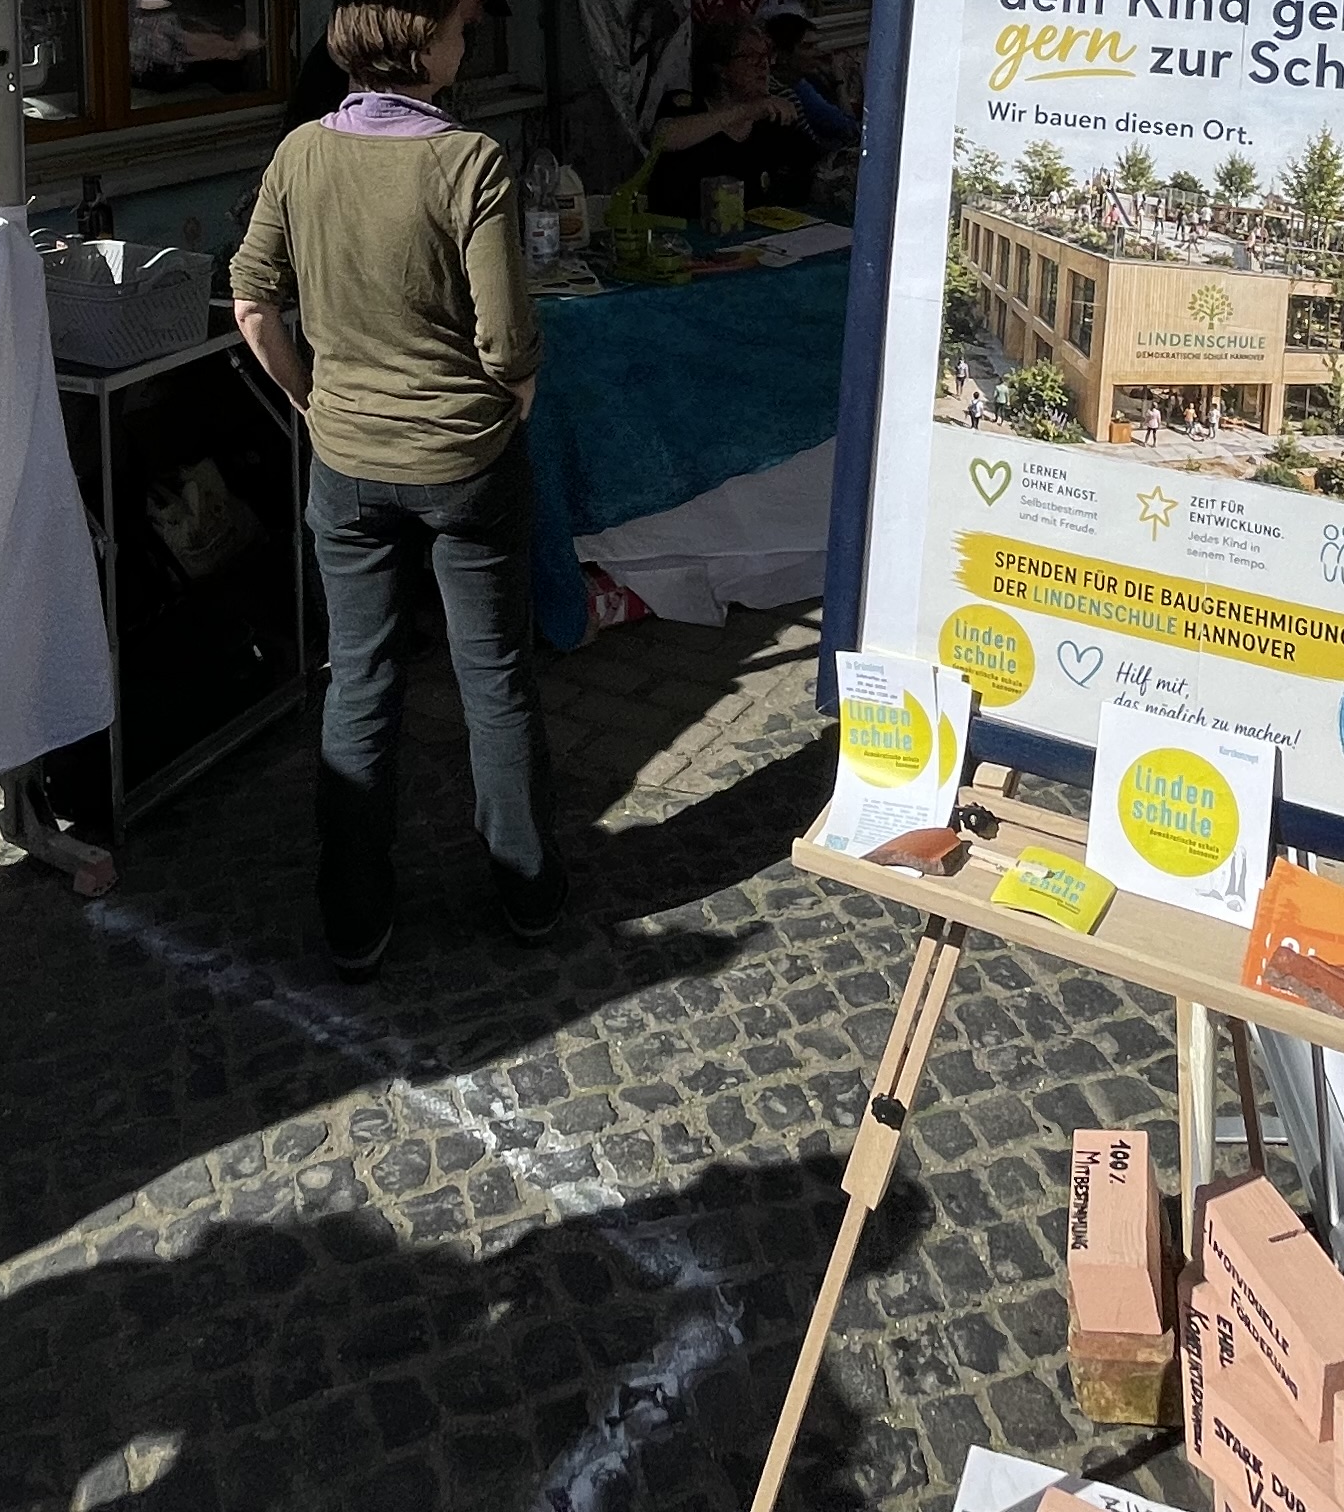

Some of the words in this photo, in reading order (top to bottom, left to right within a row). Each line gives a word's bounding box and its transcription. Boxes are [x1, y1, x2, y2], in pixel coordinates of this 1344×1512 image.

[988, 21, 1137, 91] gern
[1150, 44, 1232, 80] zur
[986, 99, 1027, 125] Wir
[1034, 104, 1107, 131] bauen
[1115, 110, 1194, 139] diesen
[1203, 118, 1254, 145] Ort.
[1137, 331, 1266, 350] LINDENSCHULE
[1136, 350, 1201, 361] DEMOKRATISCHE
[1203, 352, 1228, 361] SCHULE
[1230, 353, 1265, 362] HANNOVER
[1023, 462, 1067, 481] LERNEN
[1022, 478, 1054, 493] OHNE
[1057, 485, 1098, 503] ANGST.
[1020, 495, 1098, 521] Selbstbestimmt
[1190, 496, 1216, 510] ZEIT
[1219, 500, 1245, 515] FÜR
[1019, 511, 1039, 523] und
[1040, 515, 1057, 527] mit
[1059, 518, 1098, 535] Freude.
[1189, 512, 1284, 540] ENTWICKLUNG.
[1188, 531, 1220, 545] Jedes
[1222, 535, 1249, 551] Kind
[1250, 542, 1261, 553] in
[1186, 547, 1225, 562] seinem
[1228, 552, 1268, 571] Tempo.
[995, 551, 1077, 585] SPENDEN
[1083, 569, 1118, 595] FÜR
[1125, 580, 1154, 604] DIE
[993, 575, 1027, 600] DER
[1033, 585, 1178, 635] LINDENSCHULE
[1184, 620, 1296, 662] HANNOVER
[955, 618, 1016, 653] linden
[953, 644, 1017, 674] schule
[1116, 661, 1153, 696] Hilf
[1156, 677, 1190, 700] mit,
[849, 699, 911, 728] linden
[1113, 691, 1140, 711] das
[1211, 717, 1231, 733] zu
[1234, 722, 1302, 750] machen!
[849, 726, 913, 752] schule
[1135, 765, 1214, 809] linden
[1132, 799, 1212, 838] schule
